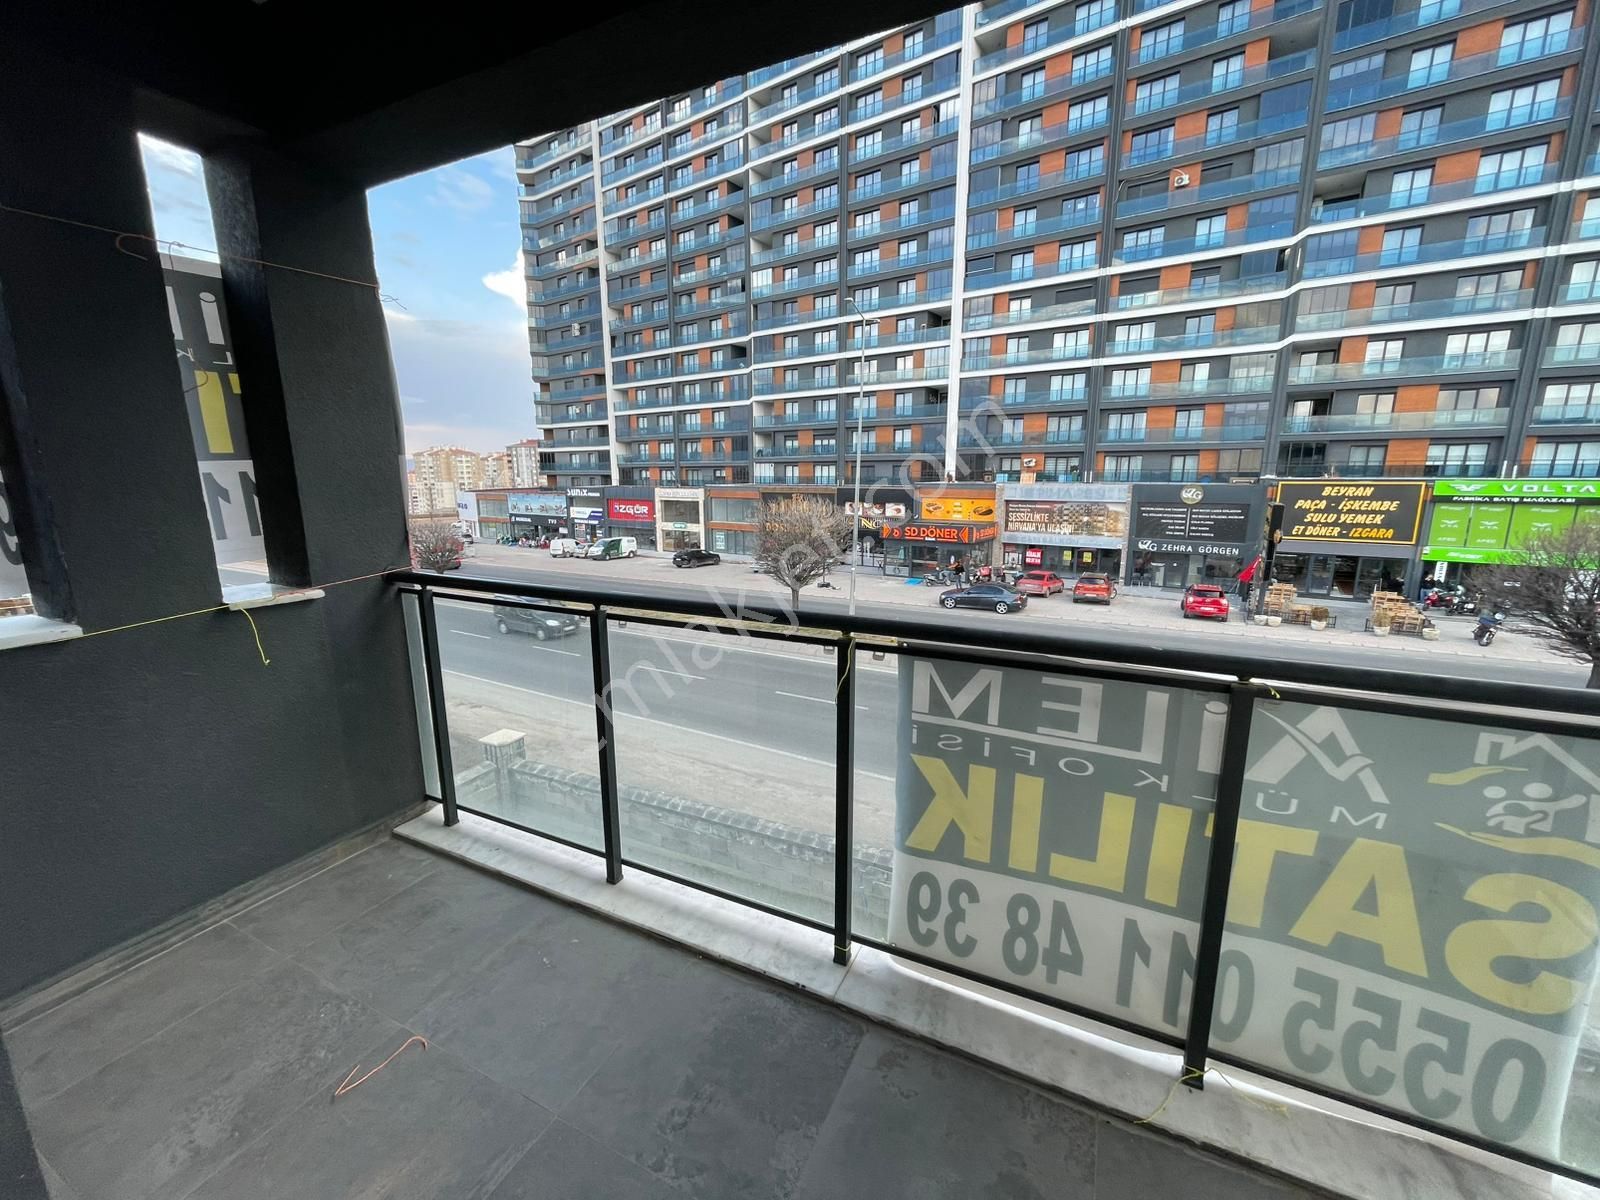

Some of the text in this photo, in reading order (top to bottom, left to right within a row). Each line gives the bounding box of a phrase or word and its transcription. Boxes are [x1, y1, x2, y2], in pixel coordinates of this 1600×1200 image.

[1321, 485, 1375, 497] BEYRAN
[1502, 484, 1597, 494] VOLTA
[1294, 499, 1327, 512] PAÇA
[1338, 498, 1400, 512] İŞKEMBE
[1008, 511, 1050, 523] SESSİZLİKTE
[1304, 513, 1385, 525] SULU YEMEK
[904, 526, 918, 536] SD
[920, 526, 958, 539] DÖNER
[1007, 521, 1046, 532] NİRVANA'YA
[1292, 526, 1304, 535] ET
[1305, 525, 1341, 537] DÖNER
[1349, 528, 1394, 539] IZGARA
[1161, 544, 1193, 553] ZEHRA
[1198, 544, 1239, 555] GÖRGEN
